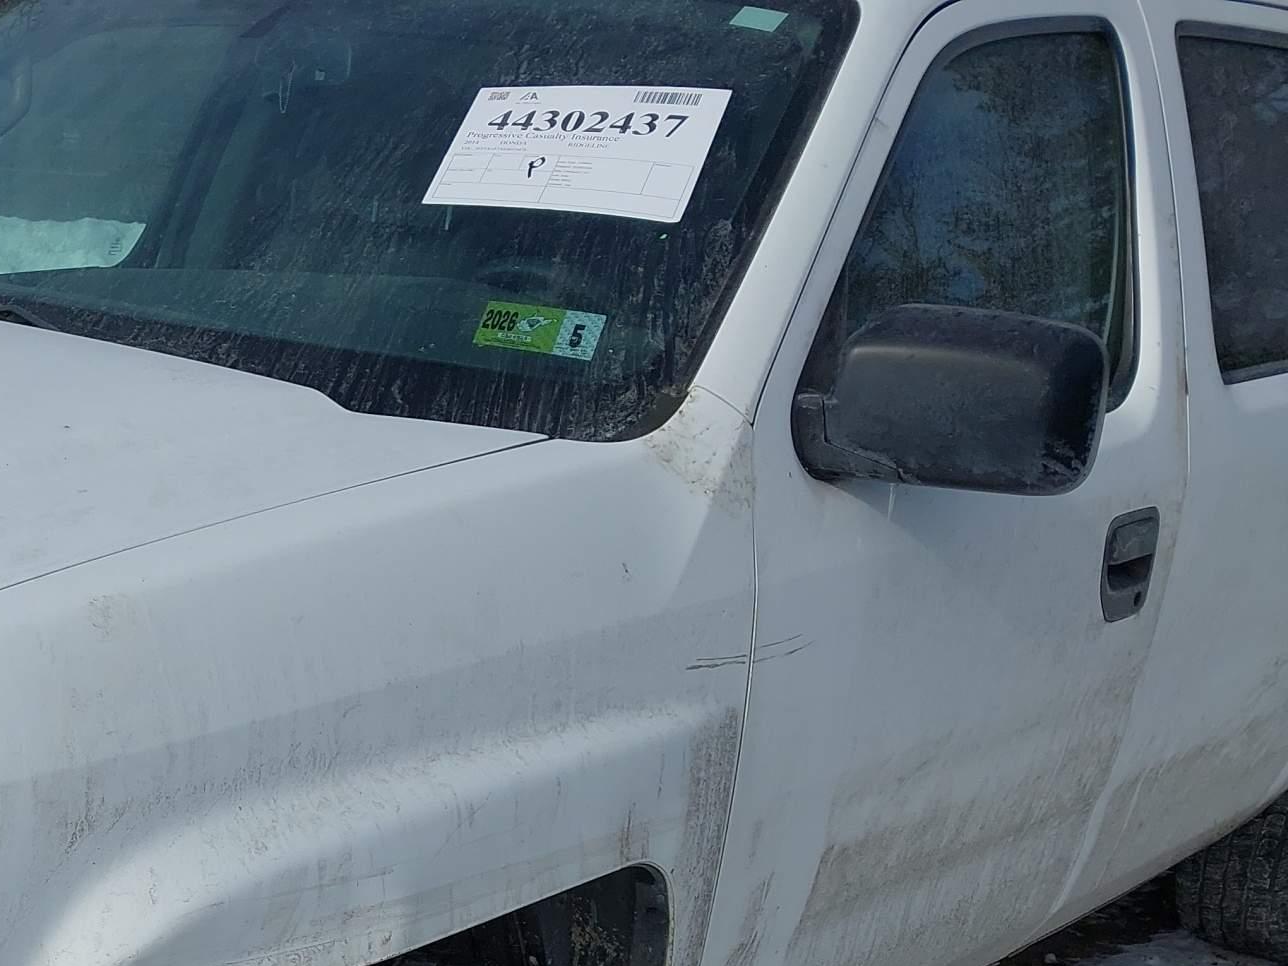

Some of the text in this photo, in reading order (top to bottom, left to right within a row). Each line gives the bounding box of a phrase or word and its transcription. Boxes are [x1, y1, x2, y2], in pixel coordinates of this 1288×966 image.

[488, 110, 688, 138] 44302437
[467, 131, 620, 142] Progressive Casualty Insurance
[482, 309, 519, 331] 2026
[569, 324, 586, 348] 5
